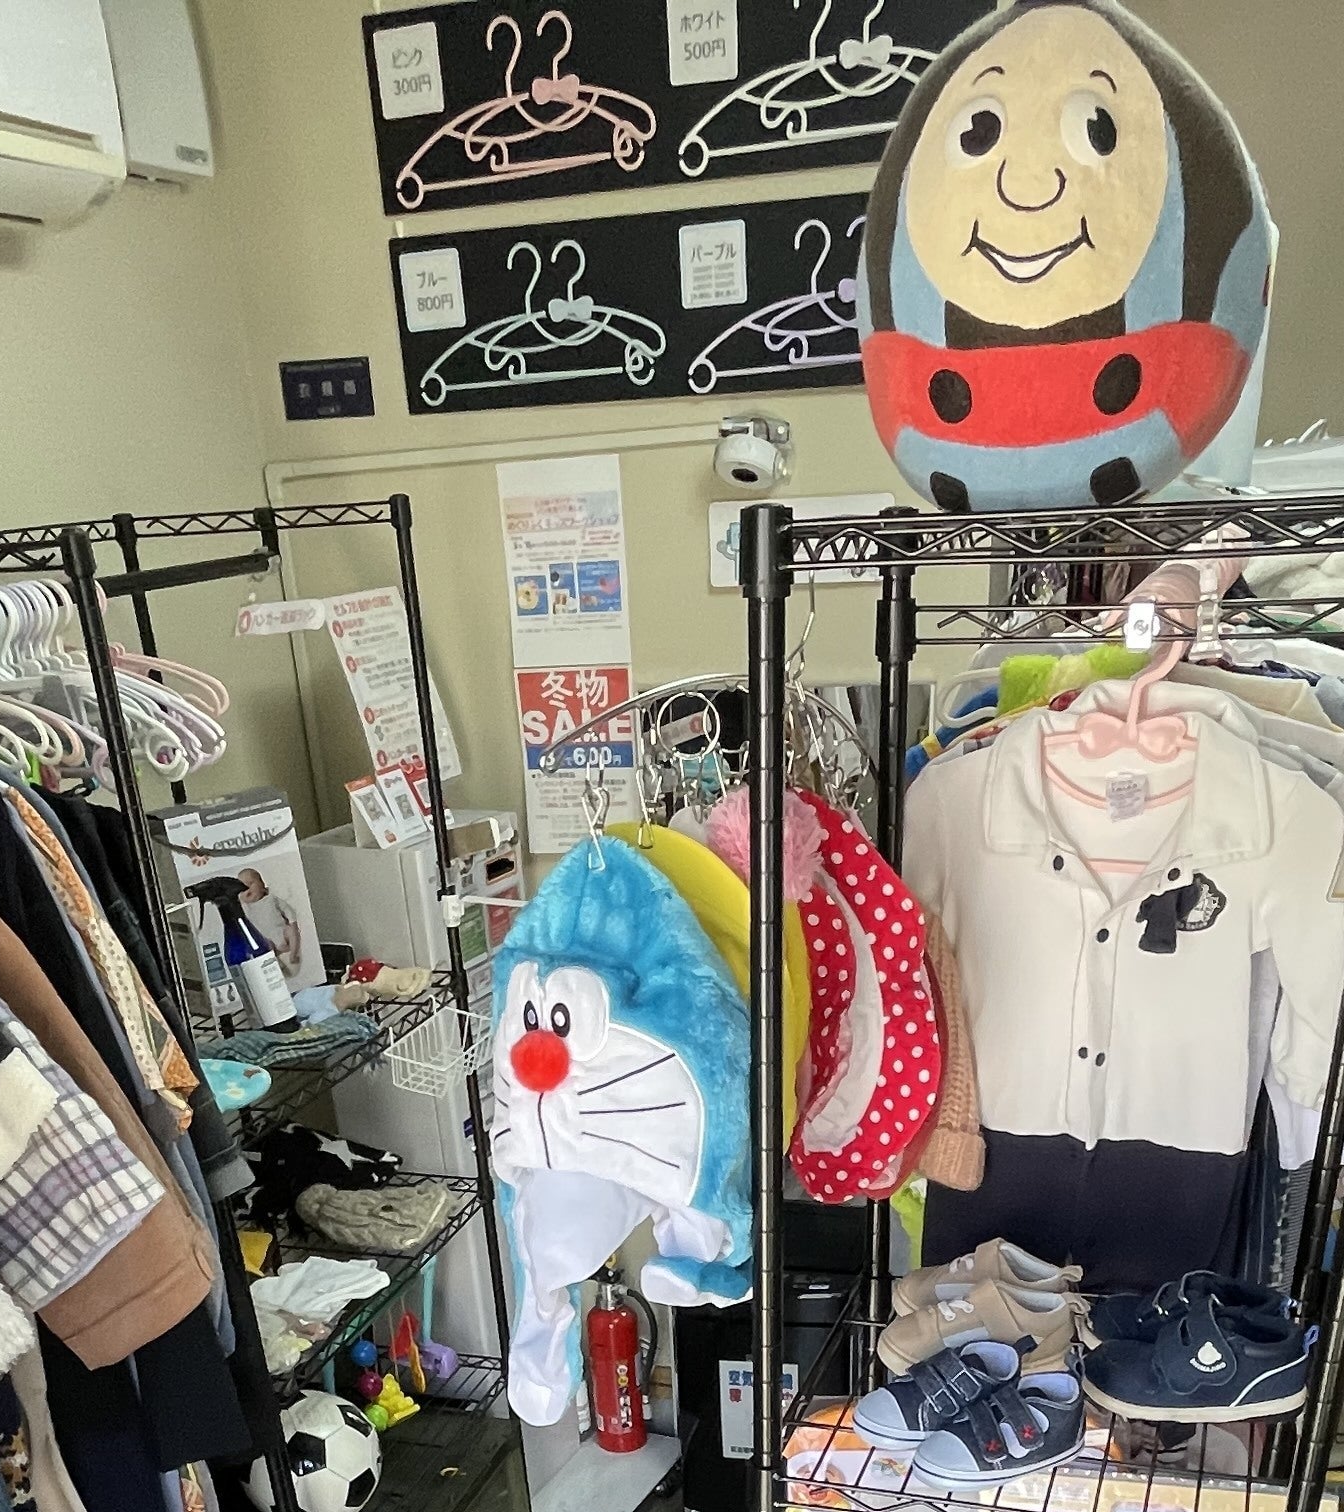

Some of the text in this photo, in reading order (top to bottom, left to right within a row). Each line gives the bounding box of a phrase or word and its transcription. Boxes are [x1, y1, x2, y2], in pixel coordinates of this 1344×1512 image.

[680, 10, 725, 32] ホワイト
[684, 38, 726, 61] 500円
[393, 73, 432, 96] 300円
[690, 241, 737, 262] パープル
[416, 271, 448, 289] ブルー
[417, 293, 454, 312] 800円
[540, 669, 610, 710] 冬物
